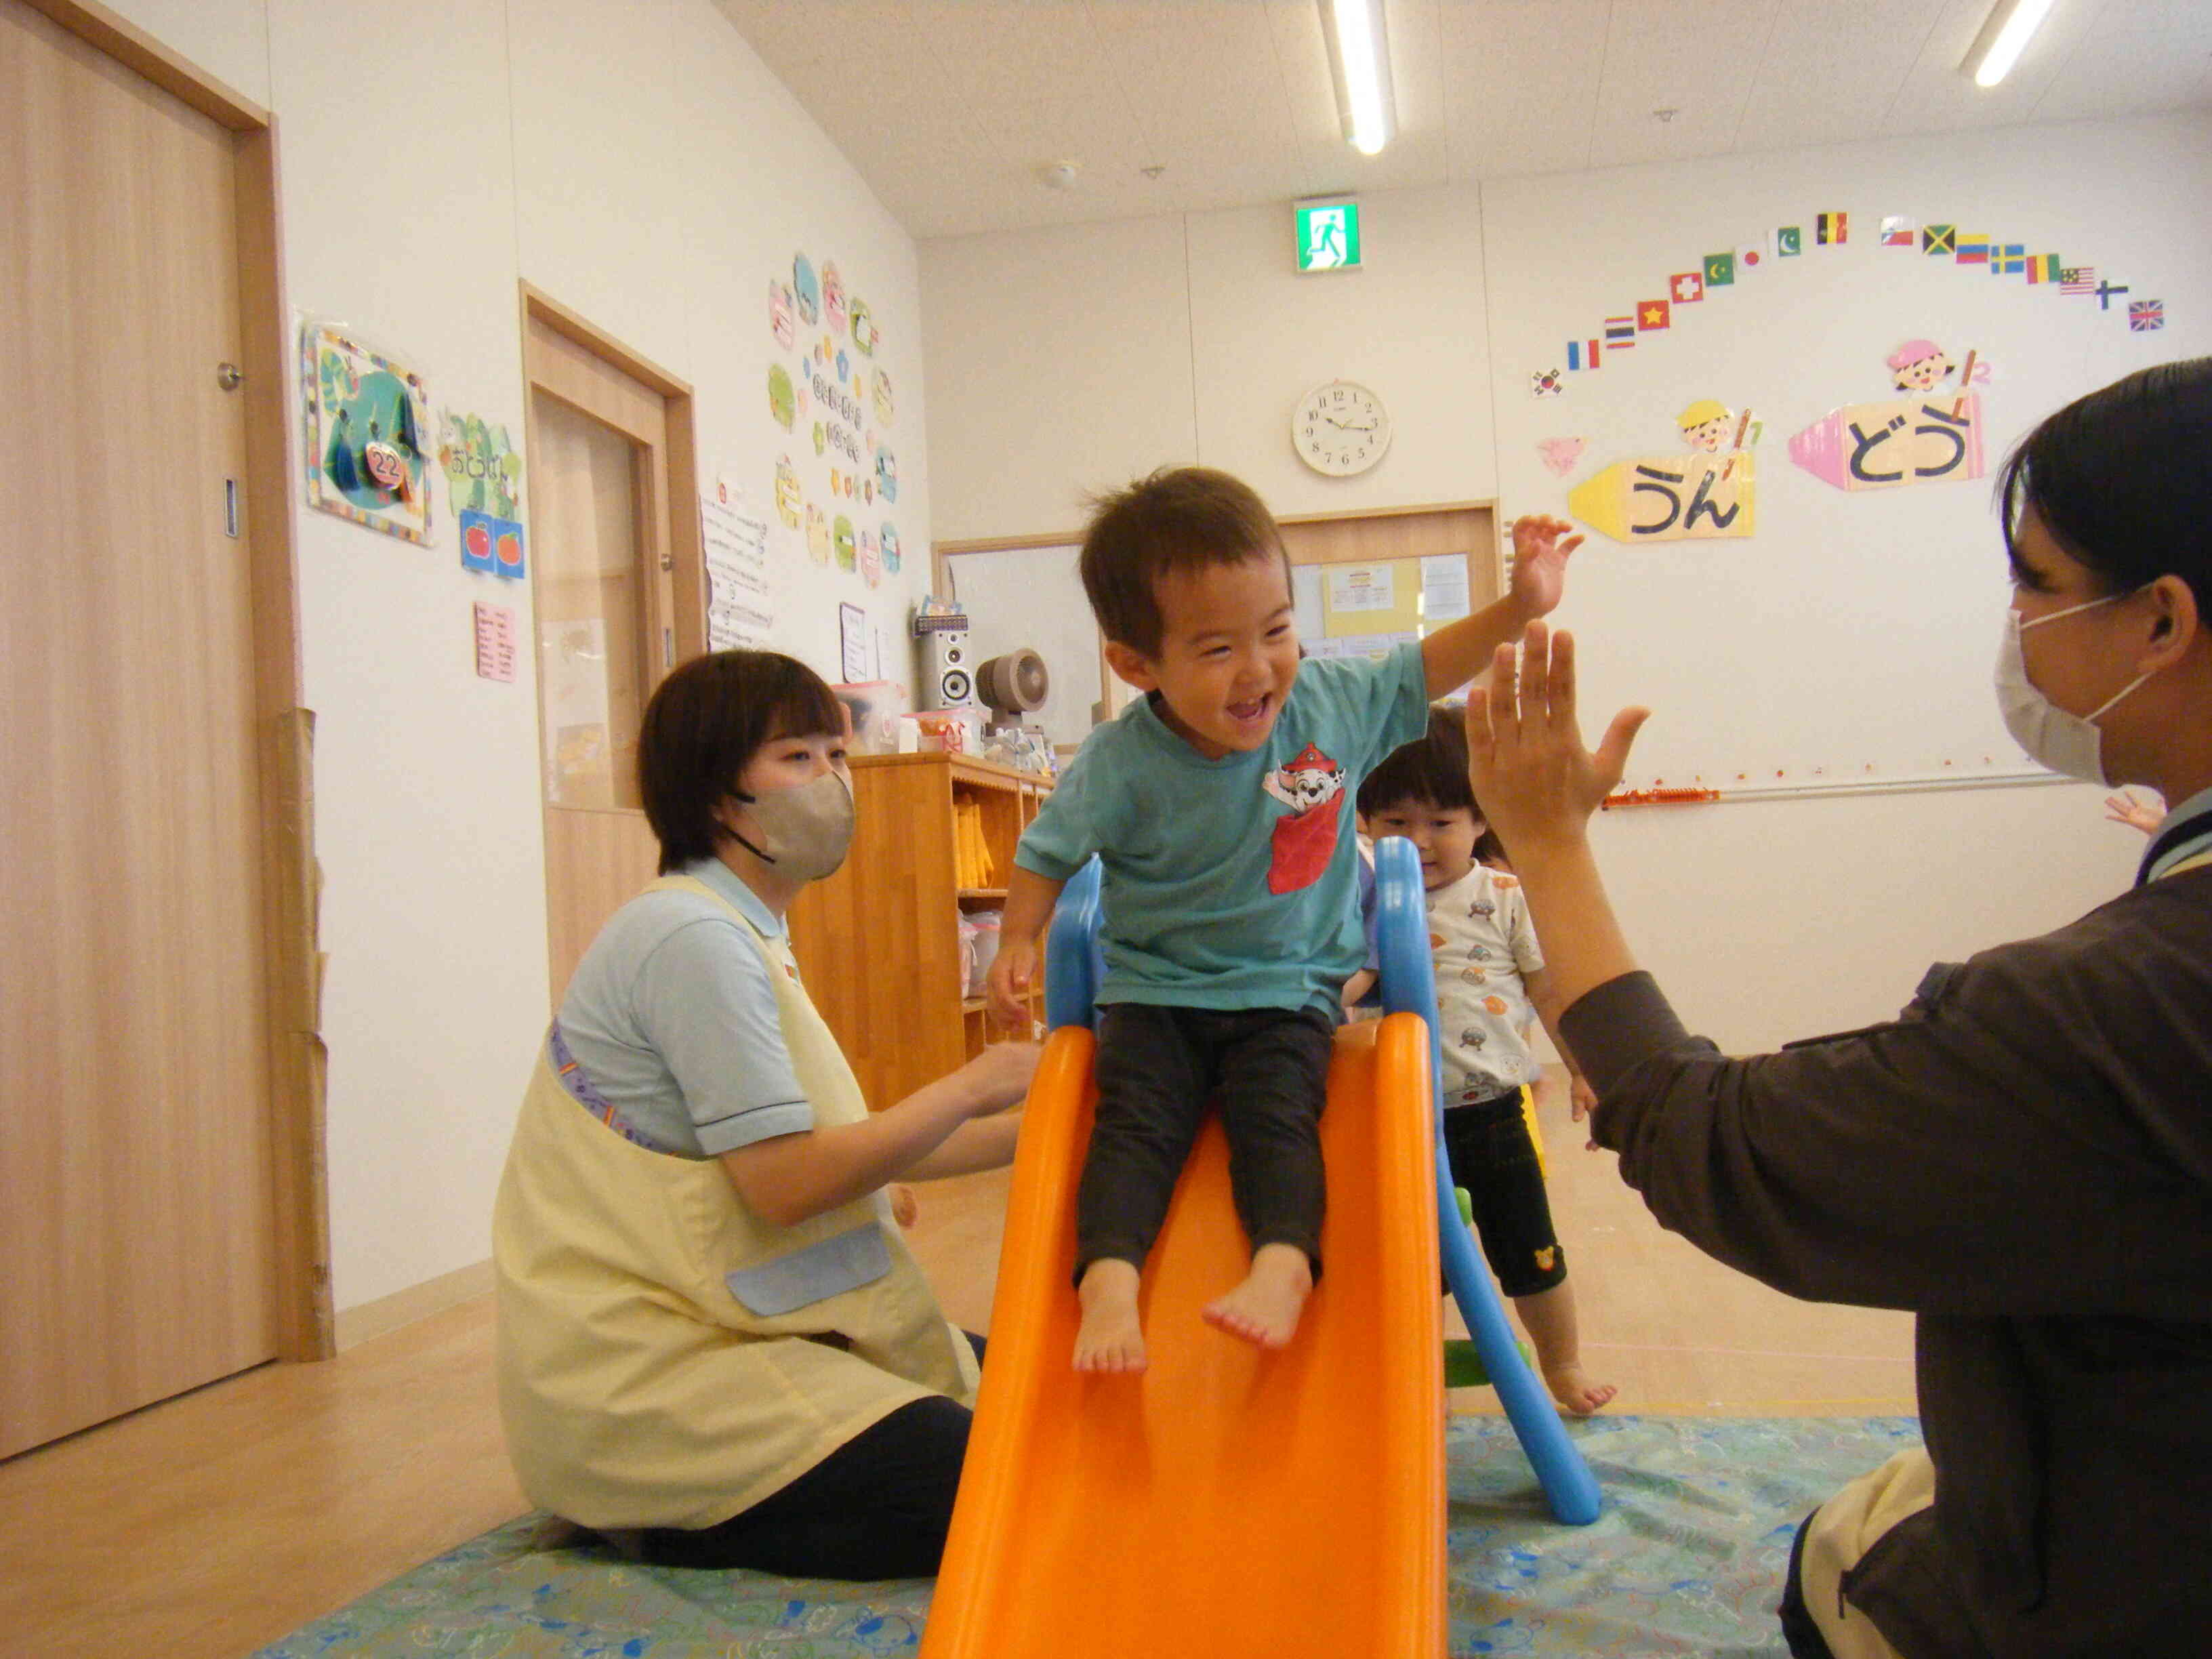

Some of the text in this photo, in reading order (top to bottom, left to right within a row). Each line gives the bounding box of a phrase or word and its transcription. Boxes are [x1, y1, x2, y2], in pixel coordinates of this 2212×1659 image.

[1333, 390, 1344, 401] 12
[1318, 396, 1326, 407] 11
[1365, 402, 1372, 413] 2
[1308, 410, 1318, 422] 10
[1371, 417, 1378, 428] 3
[1306, 428, 1313, 438] 9
[1367, 434, 1373, 445] 4
[1849, 405, 1970, 482] どう
[1312, 442, 1319, 453] 8
[1325, 452, 1332, 464] 7
[1357, 448, 1365, 459] 5
[373, 450, 400, 477] 22
[1341, 454, 1349, 465] 6
[1631, 465, 1740, 534] うん
